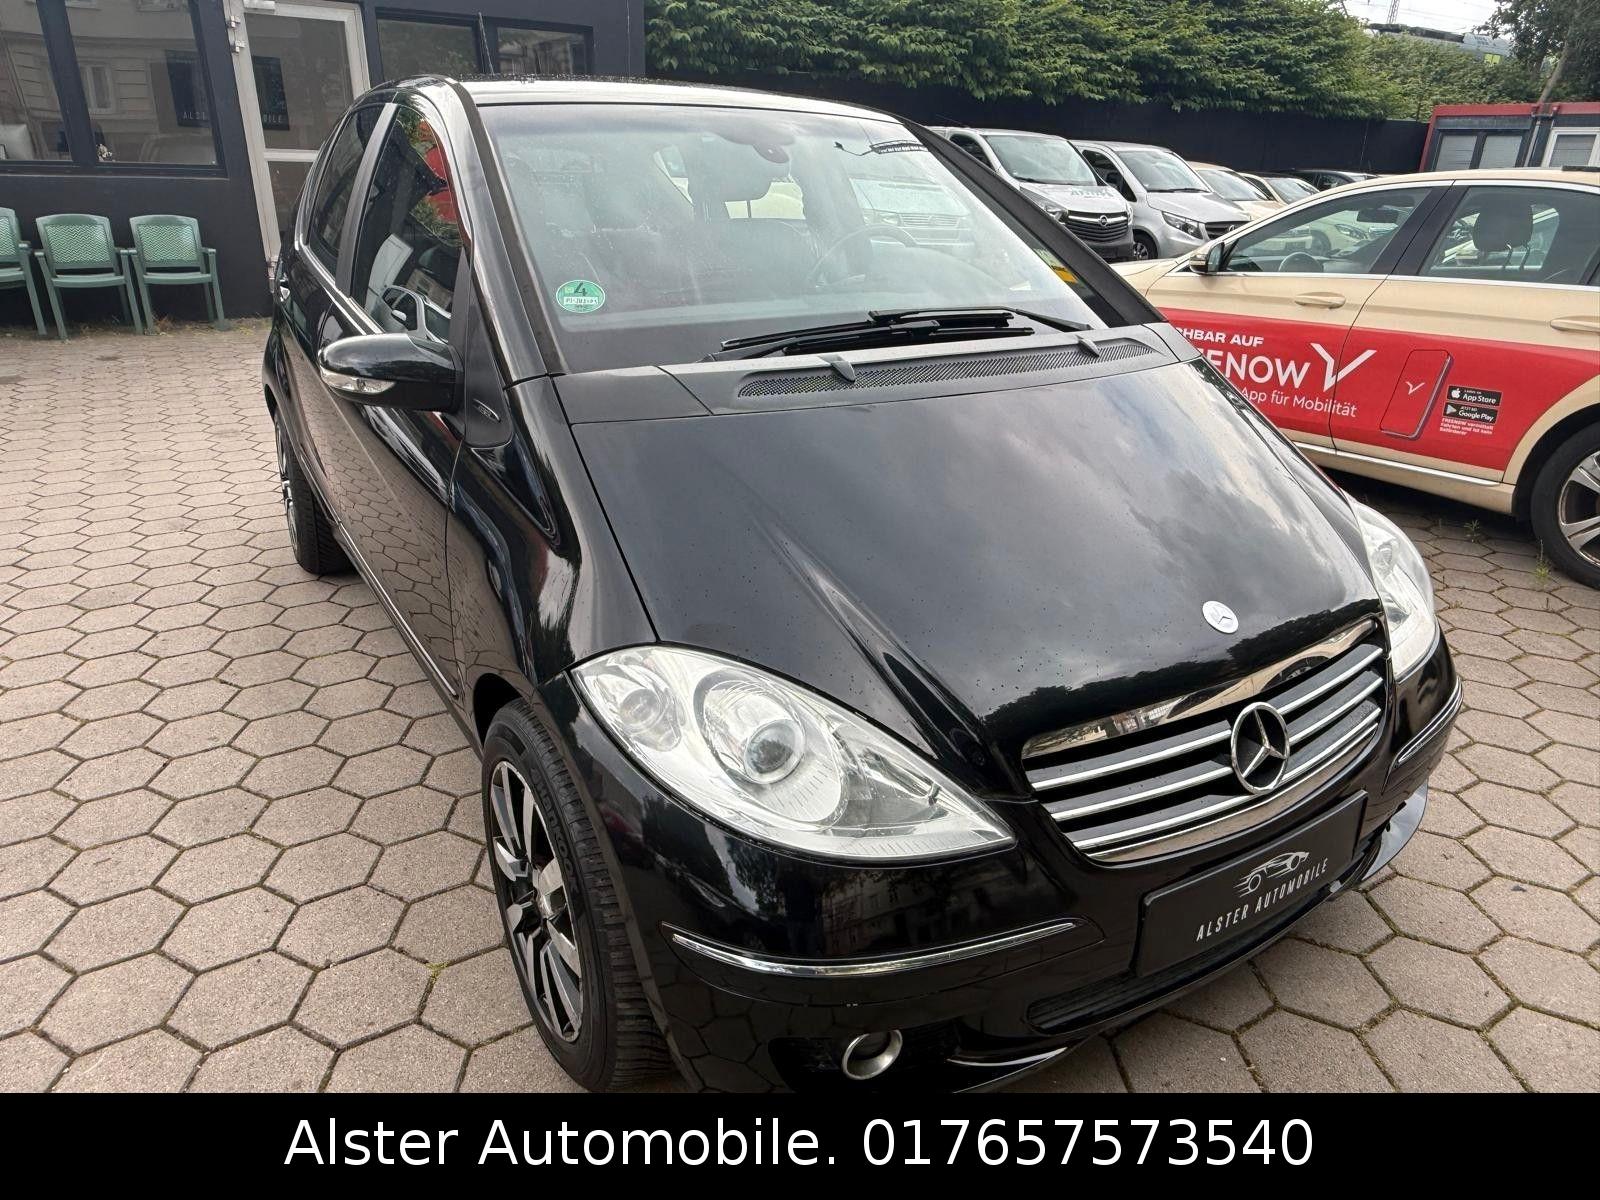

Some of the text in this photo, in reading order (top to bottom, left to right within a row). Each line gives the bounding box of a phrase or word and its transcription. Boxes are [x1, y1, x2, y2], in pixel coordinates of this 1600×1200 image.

[574, 282, 588, 297] 4
[1176, 326, 1265, 348] HBAR AUF
[1197, 347, 1311, 389] ENOW
[1241, 386, 1357, 418] App für Mobilität
[1463, 394, 1497, 404] App Store
[1458, 410, 1494, 422] Google Play
[1195, 857, 1329, 942] ALSTER AUTOMOBILE
